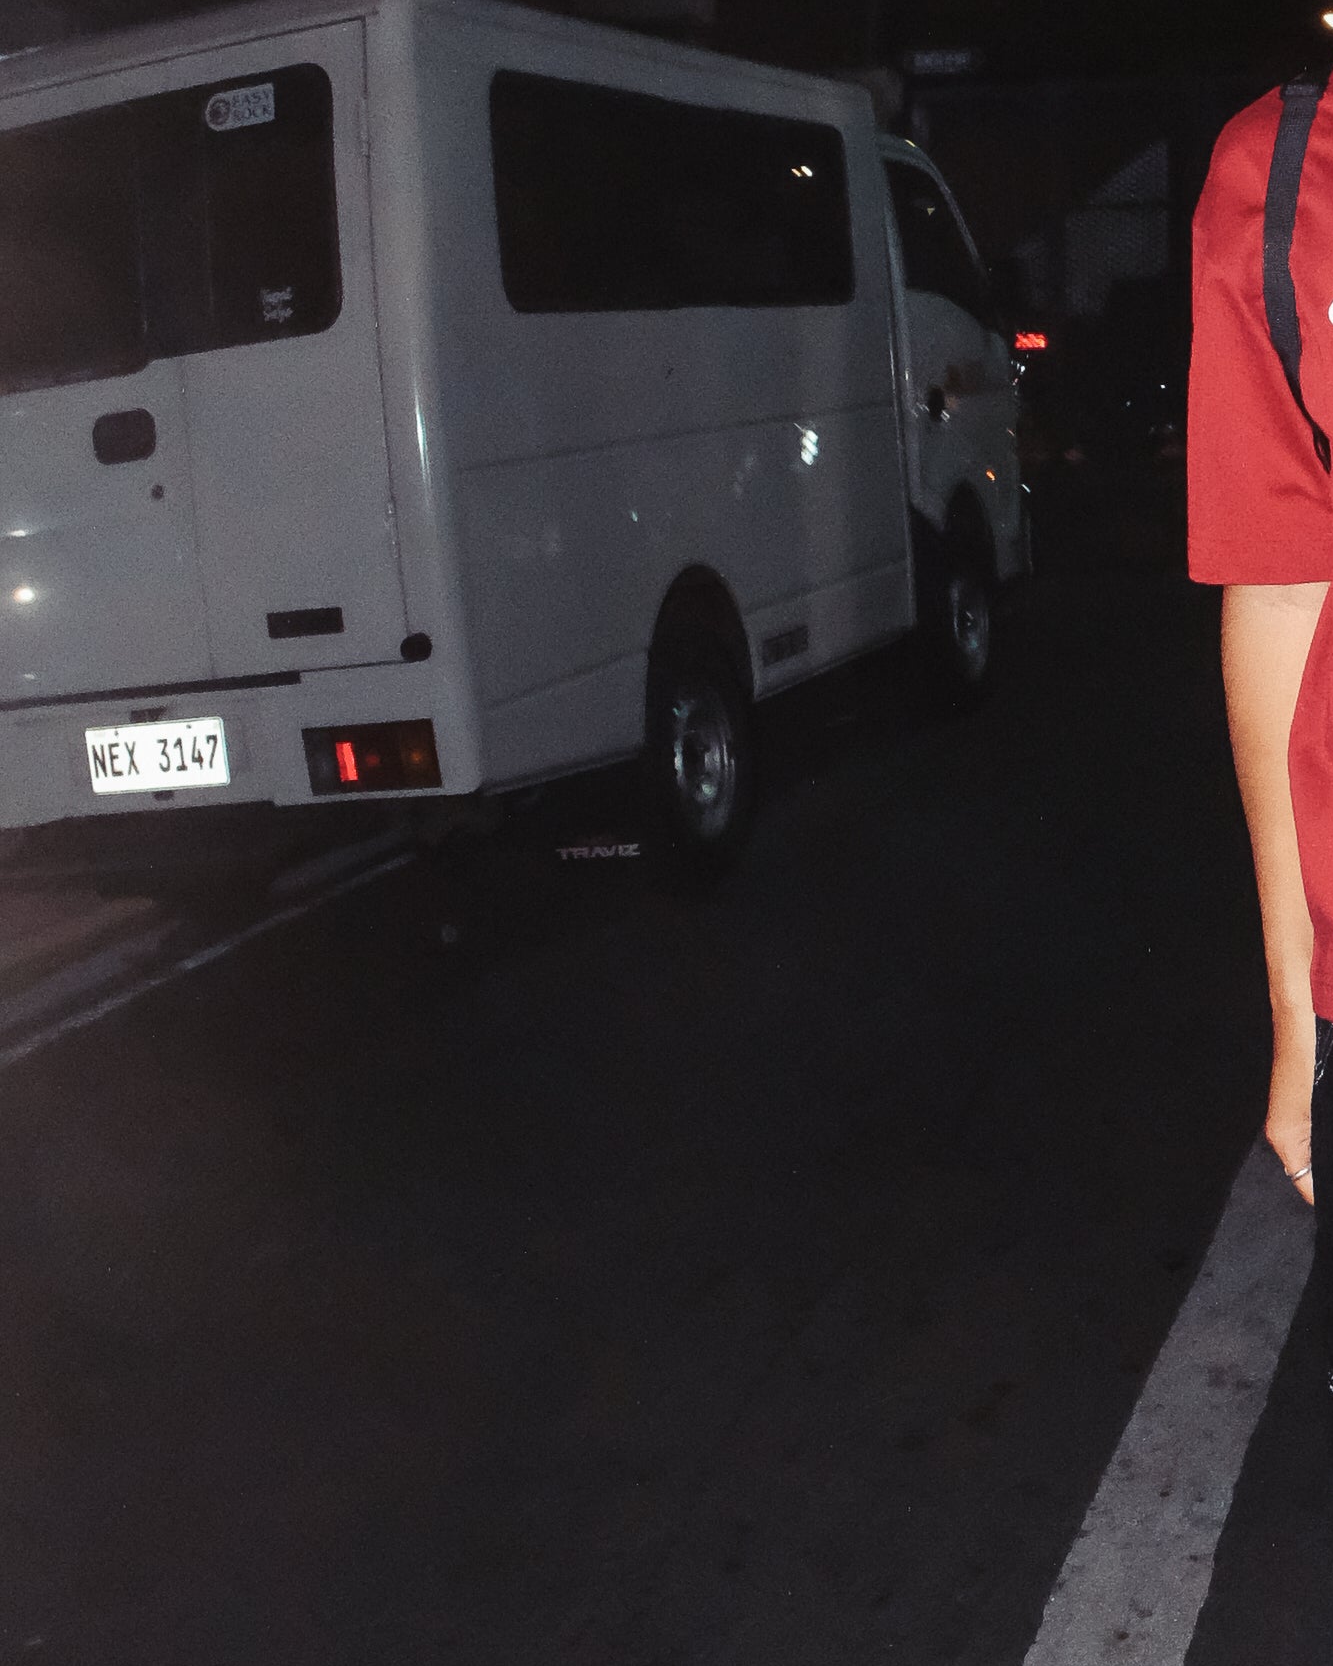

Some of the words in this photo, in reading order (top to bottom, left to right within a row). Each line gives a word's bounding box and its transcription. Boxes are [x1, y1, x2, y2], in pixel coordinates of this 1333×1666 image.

[91, 741, 140, 779] NEX
[157, 734, 218, 773] 3147
[555, 843, 641, 861] TRAVIZ
